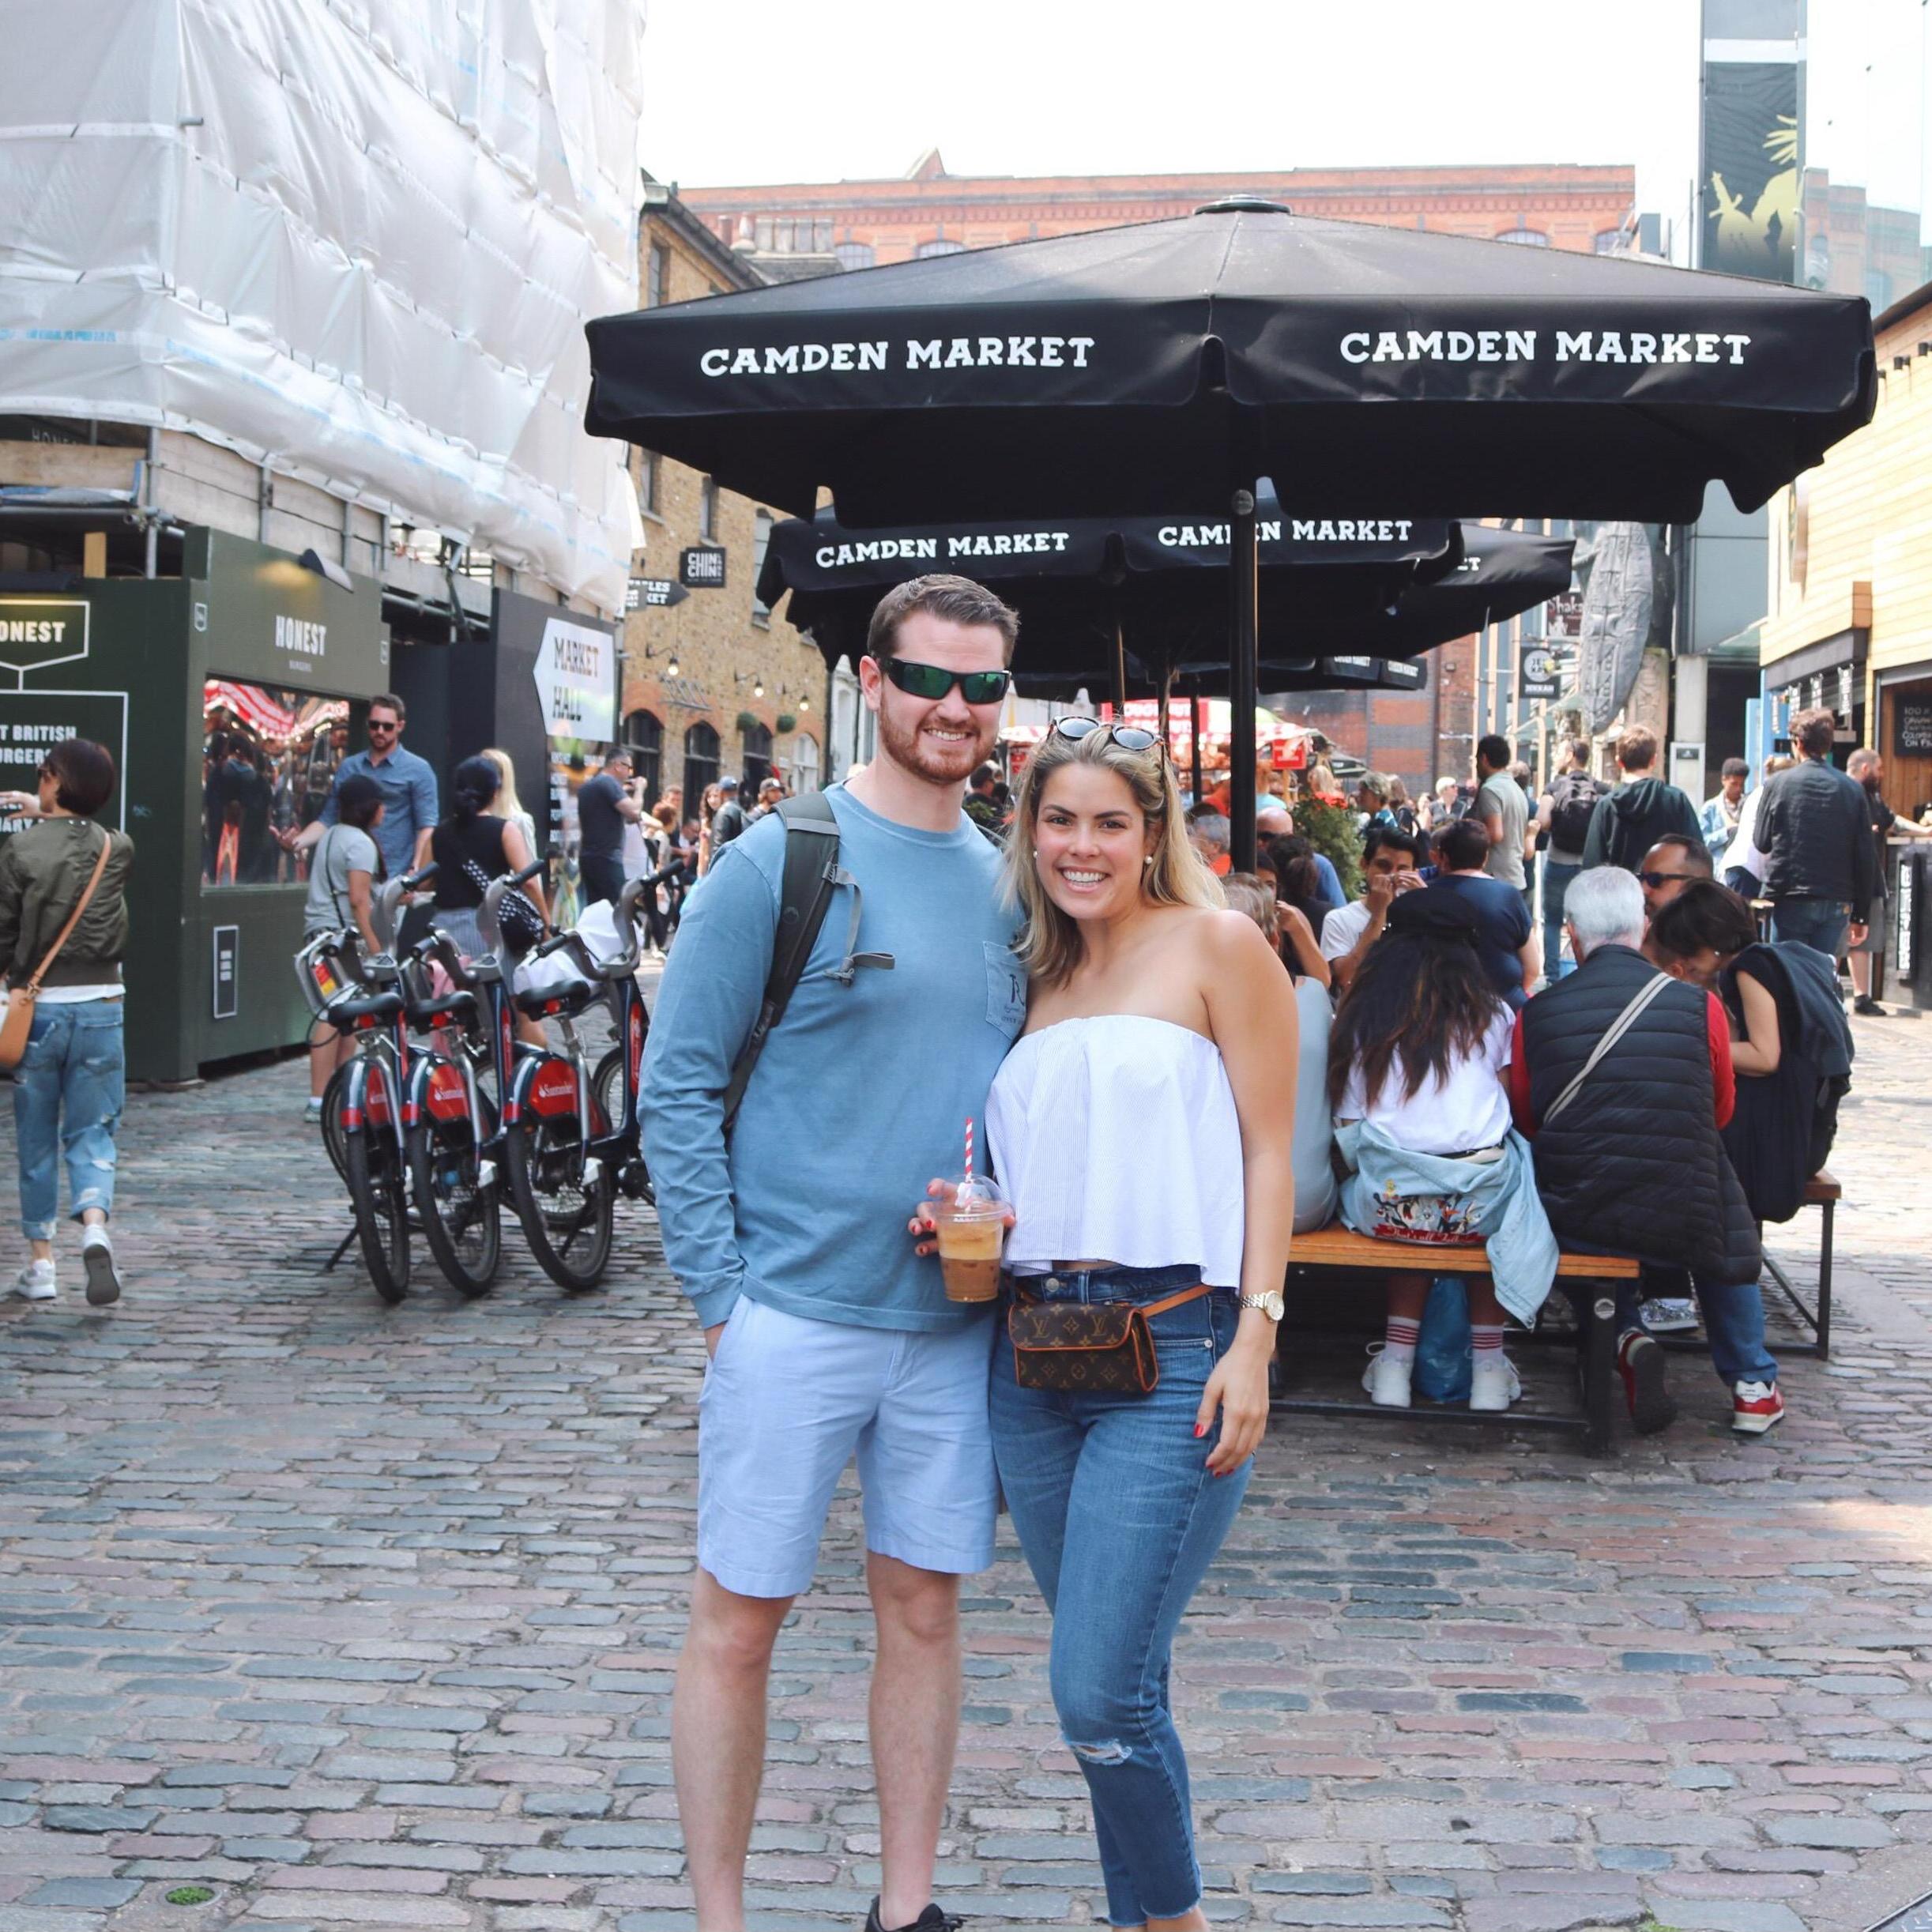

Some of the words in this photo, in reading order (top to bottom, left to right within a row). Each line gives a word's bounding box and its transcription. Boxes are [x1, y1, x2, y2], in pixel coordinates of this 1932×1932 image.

[700, 341, 888, 377] CAMDEN
[906, 336, 1095, 369] MARKET
[1340, 330, 1537, 363] CAMDEN
[1555, 331, 1752, 364] MARKET
[1158, 522, 1281, 547] CAMN
[1292, 520, 1413, 541] MARKET
[687, 552, 717, 566] CHIN
[815, 538, 937, 568] CAMDEN
[947, 533, 1070, 557] MARKET
[687, 564, 717, 578] CHIN
[0, 621, 66, 642] ONEST
[275, 615, 327, 656] HONEST
[554, 637, 598, 677] MARKET
[553, 685, 582, 721] HALL
[12, 724, 77, 742] BRITISH
[0, 747, 51, 765] RGER
